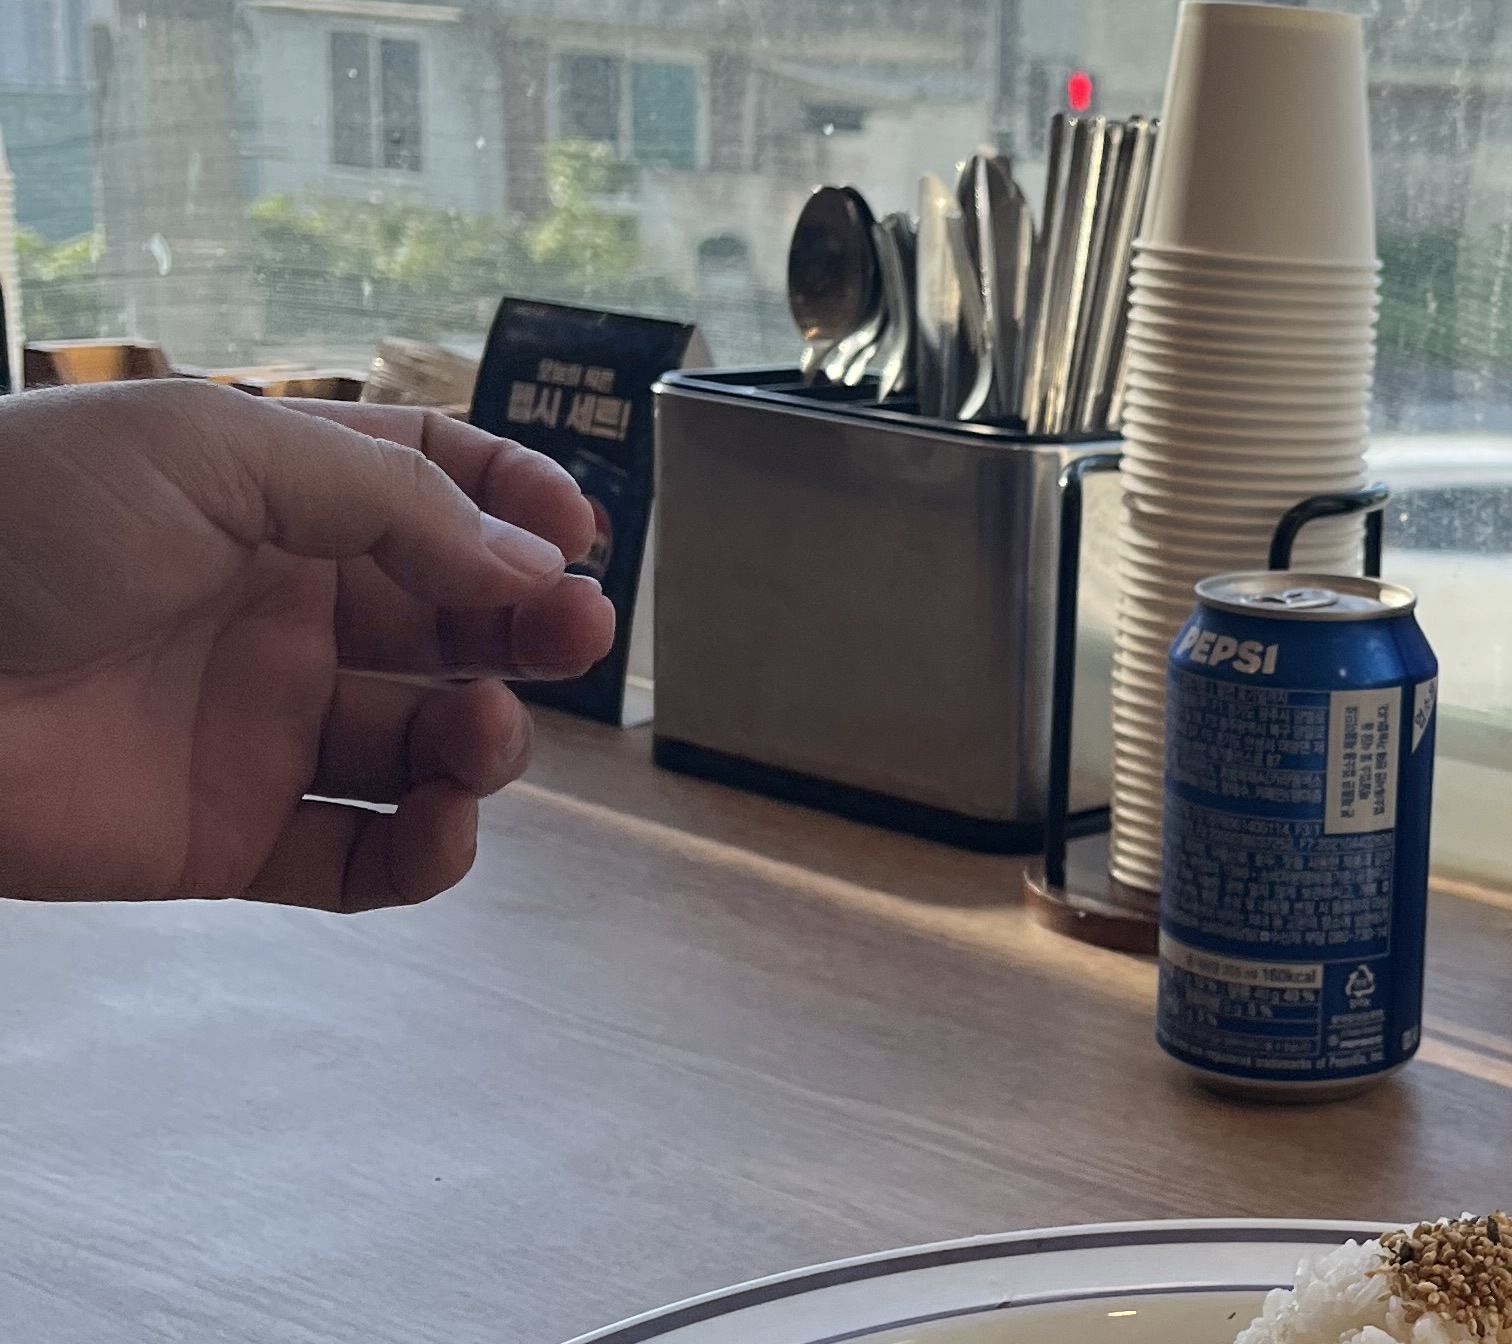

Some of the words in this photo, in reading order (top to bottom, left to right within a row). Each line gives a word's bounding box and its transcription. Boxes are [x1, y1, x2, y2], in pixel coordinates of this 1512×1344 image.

[507, 381, 561, 429] 펩시
[567, 393, 632, 441] 세트!
[1178, 627, 1278, 675] PEPSI
